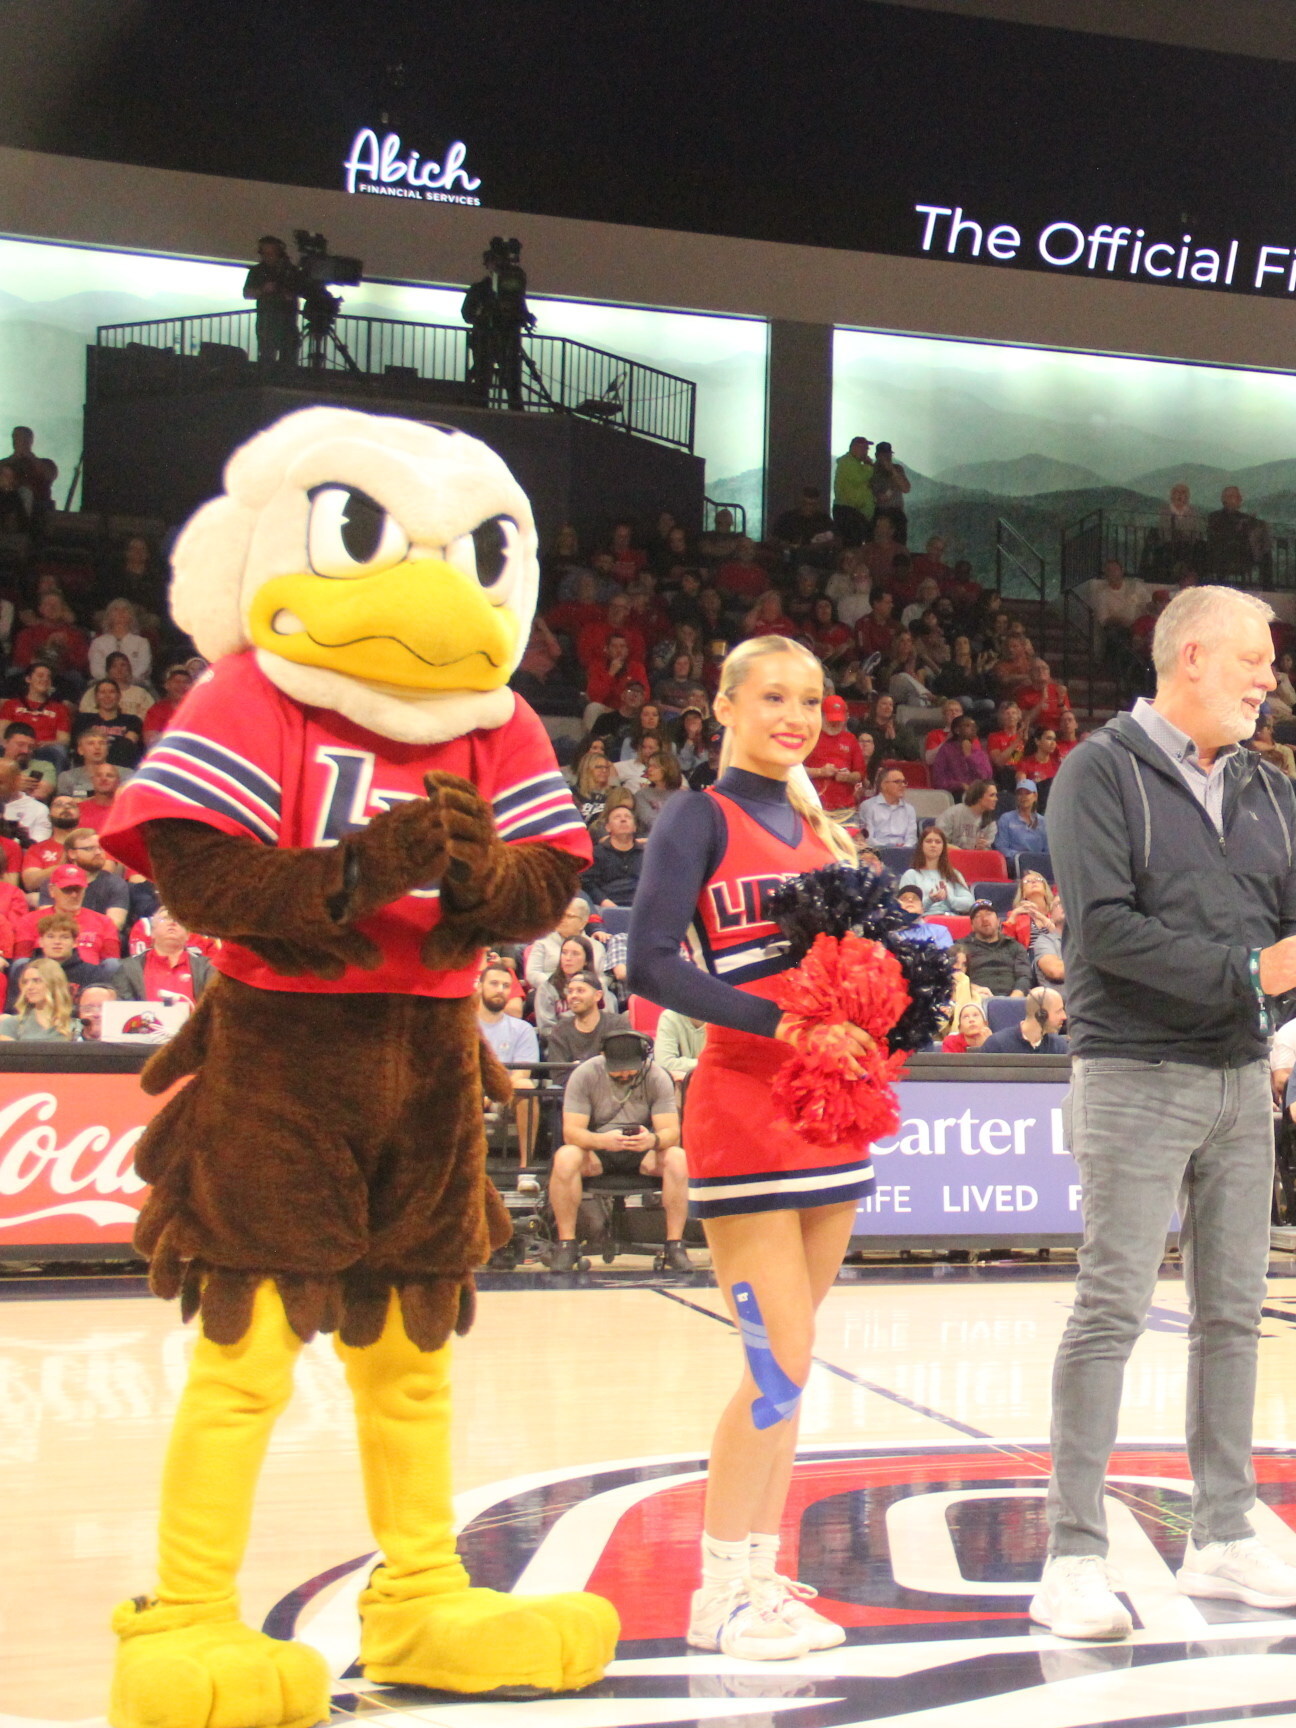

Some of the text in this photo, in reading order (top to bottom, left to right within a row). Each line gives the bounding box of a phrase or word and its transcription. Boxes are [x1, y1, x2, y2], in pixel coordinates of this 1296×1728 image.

[343, 128, 482, 194] Abich
[359, 183, 481, 206] FINANCIAL SERVICES
[915, 204, 1021, 260] The
[1039, 222, 1239, 285] Official
[869, 1108, 1037, 1156] arter
[855, 1186, 912, 1213] IFE
[943, 1185, 1039, 1212] LIVED
